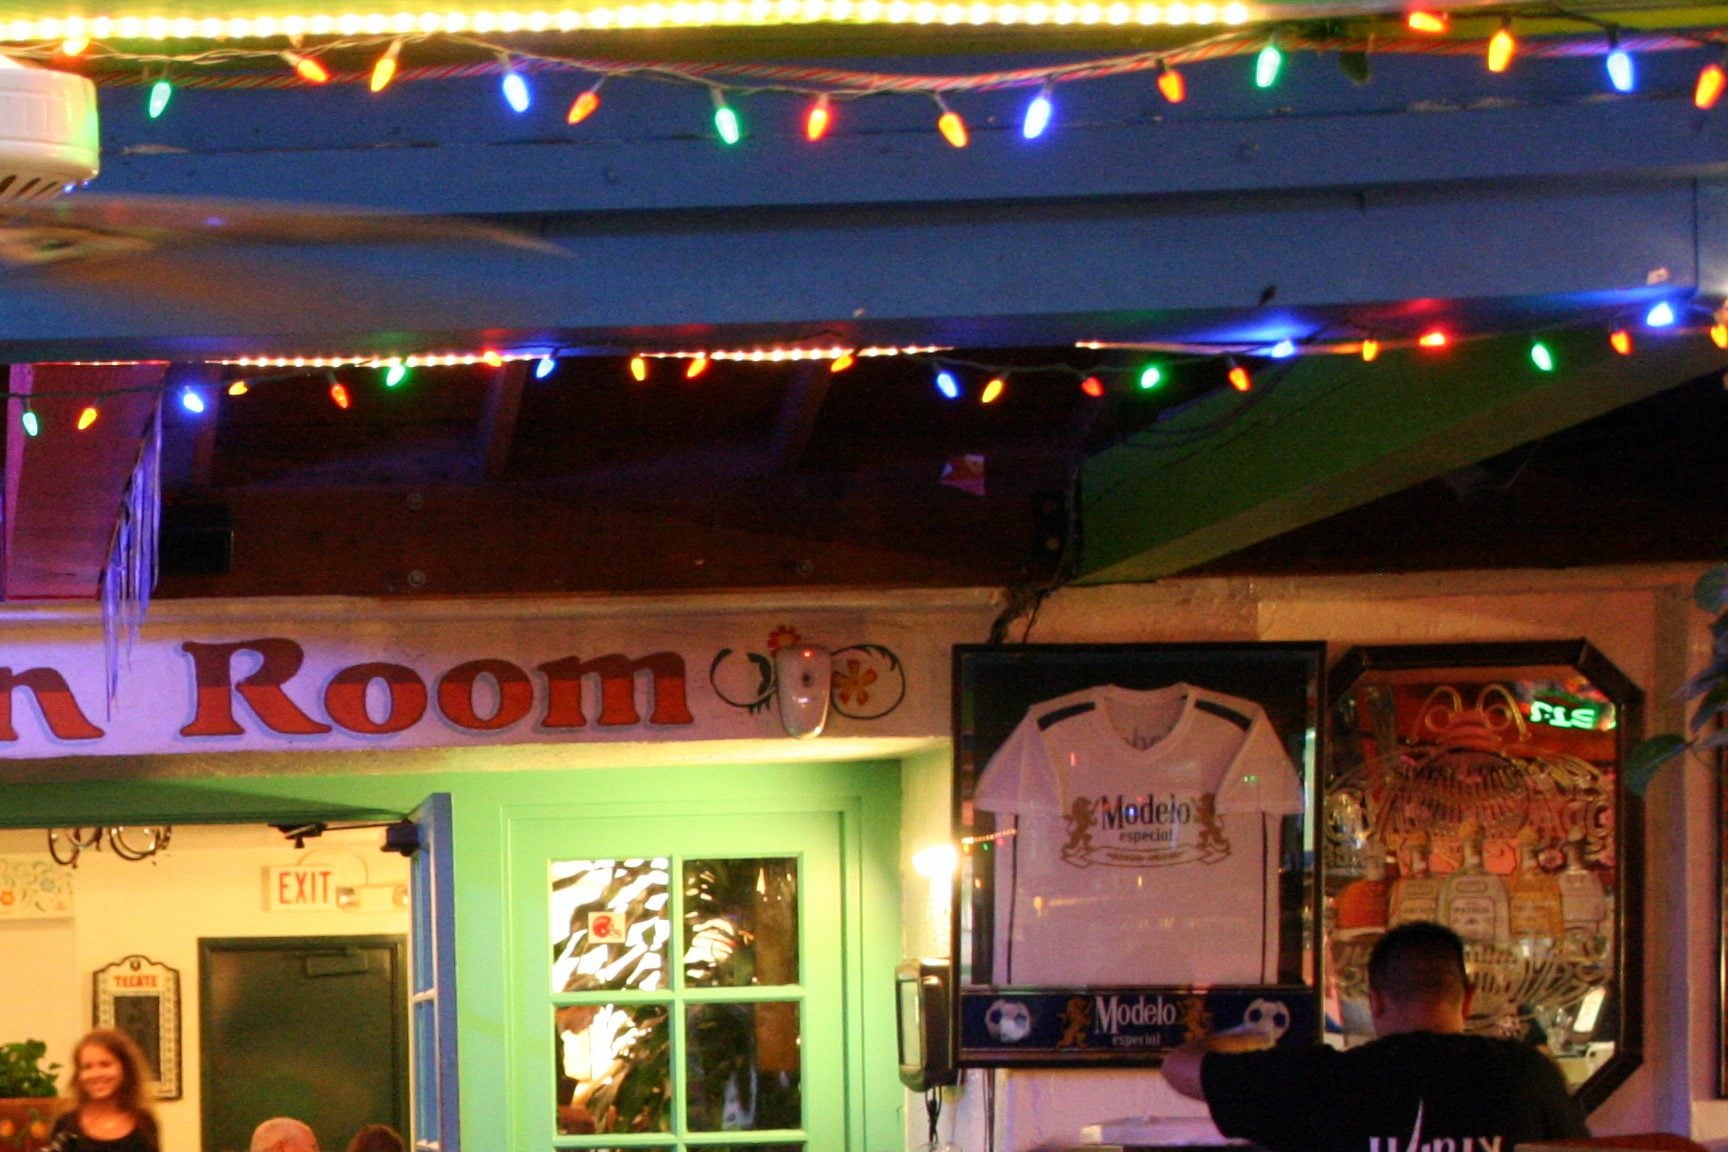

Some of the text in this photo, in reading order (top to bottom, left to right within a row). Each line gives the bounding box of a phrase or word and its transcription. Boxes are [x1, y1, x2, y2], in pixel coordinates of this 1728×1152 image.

[180, 637, 693, 737] Room
[1101, 793, 1190, 831] Modelo
[279, 871, 331, 904] EXIT
[114, 975, 157, 988] TECATE
[1094, 996, 1176, 1034] Modelo
